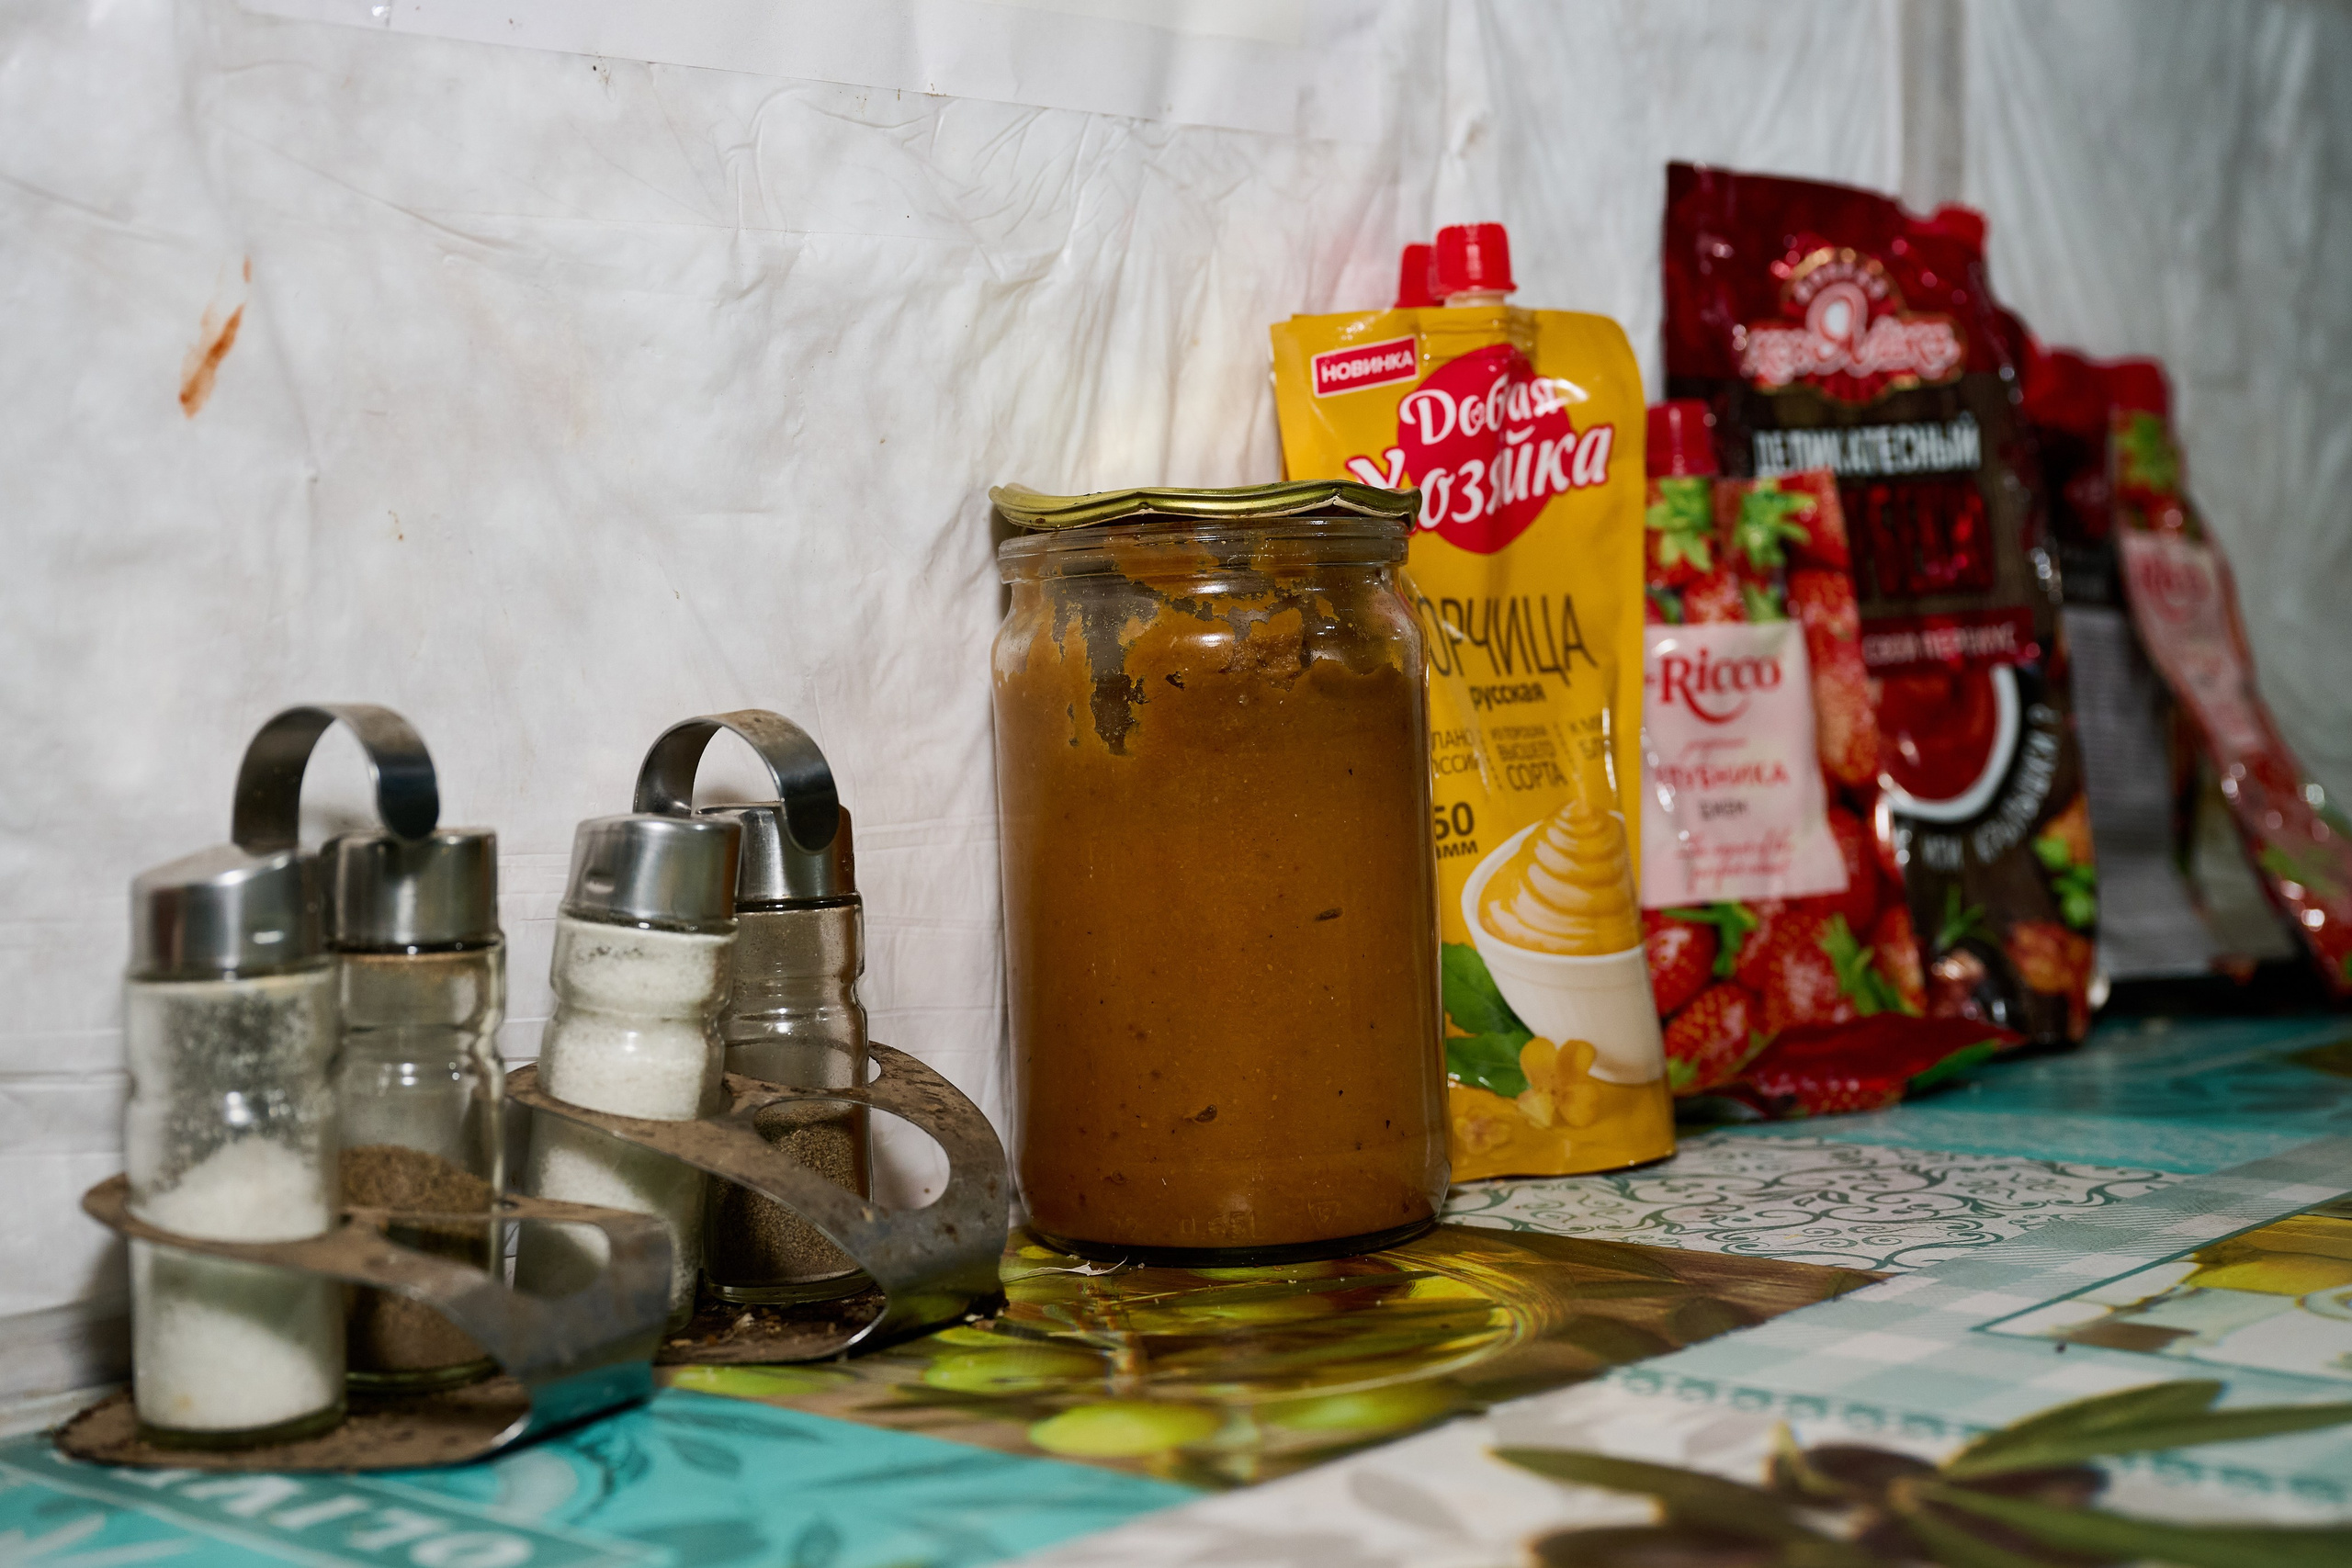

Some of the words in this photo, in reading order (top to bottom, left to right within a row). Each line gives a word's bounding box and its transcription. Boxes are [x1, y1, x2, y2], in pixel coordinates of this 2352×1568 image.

[1320, 349, 1416, 385] НОВИНКА
[1418, 592, 1598, 687] ОРЧИЦА
[1470, 682, 1547, 712] русская
